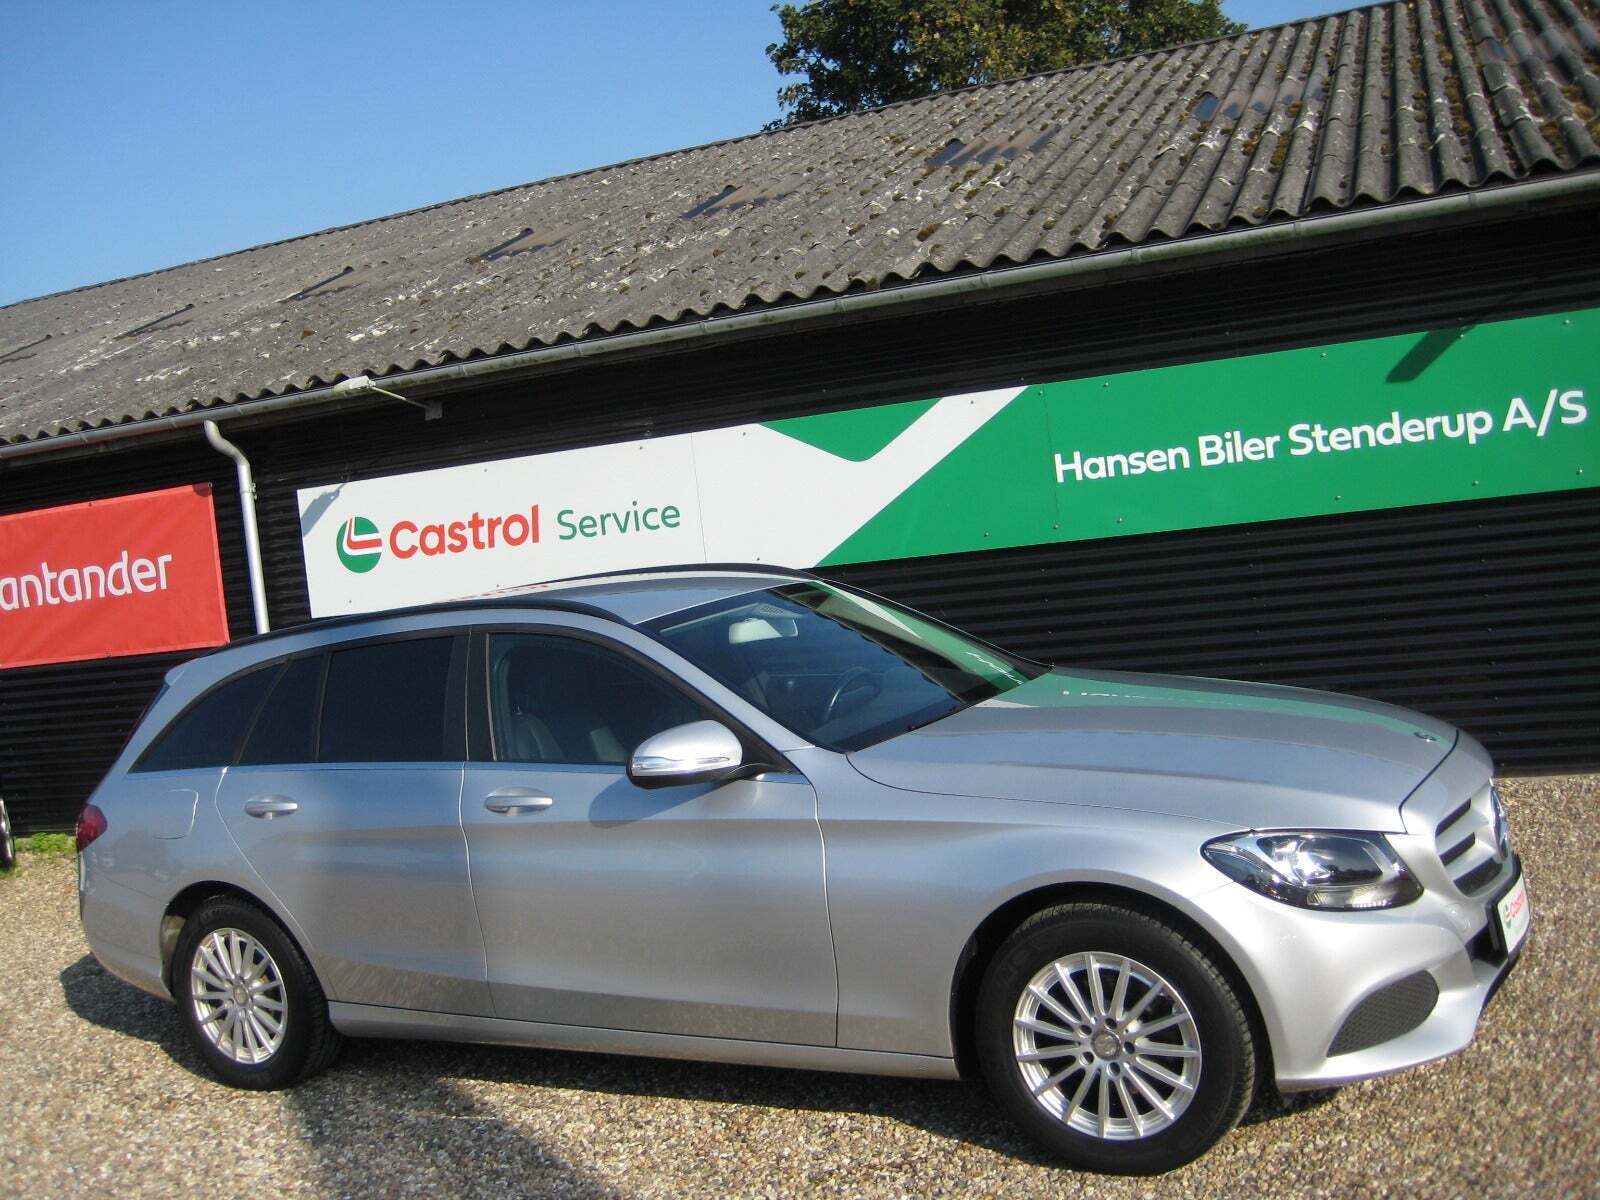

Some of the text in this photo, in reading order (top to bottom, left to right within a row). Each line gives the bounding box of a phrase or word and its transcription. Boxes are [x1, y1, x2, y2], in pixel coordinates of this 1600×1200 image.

[1054, 388, 1588, 483] Hansen Biler Stenderup A/S
[388, 500, 681, 560] Castrol Service
[0, 550, 173, 611] antander
